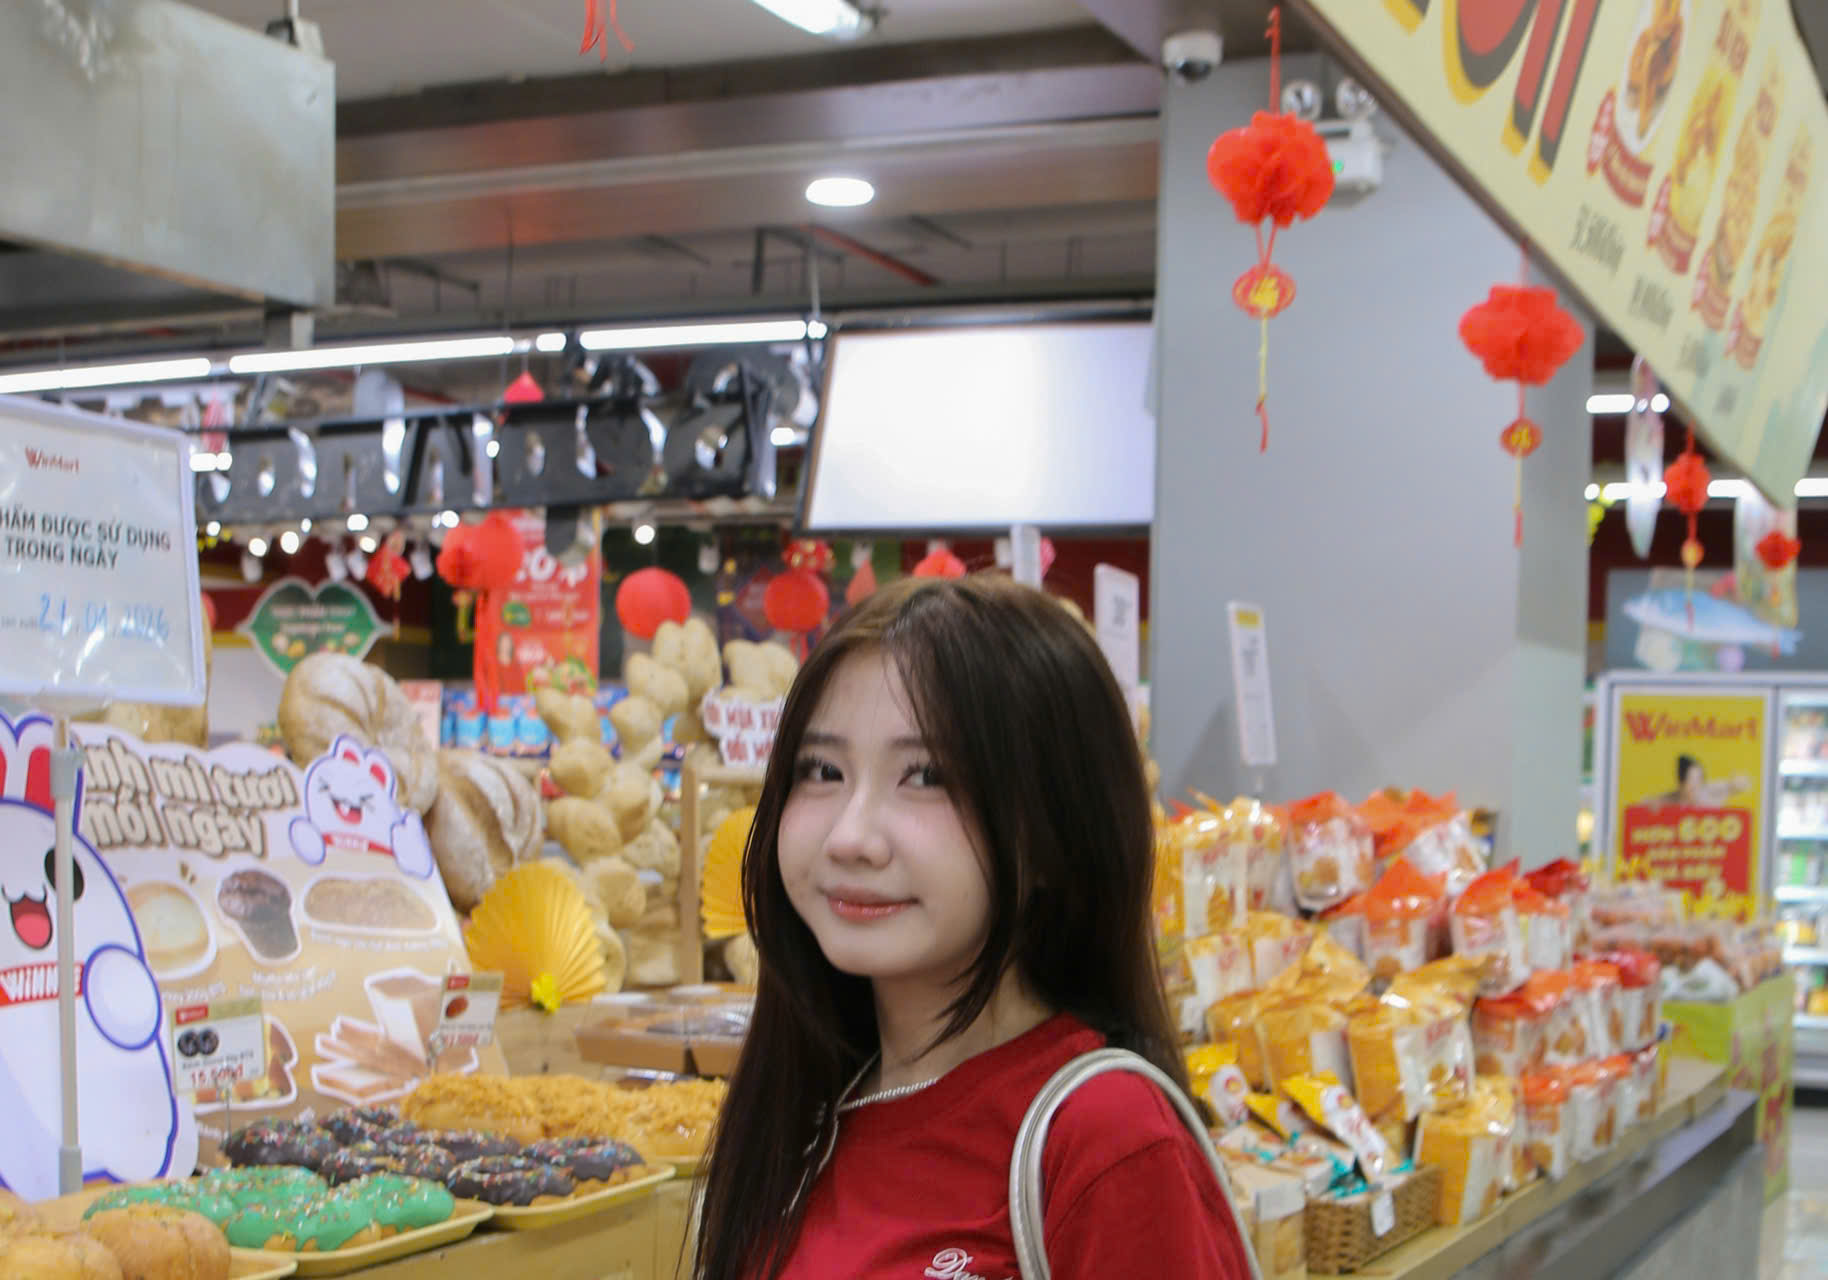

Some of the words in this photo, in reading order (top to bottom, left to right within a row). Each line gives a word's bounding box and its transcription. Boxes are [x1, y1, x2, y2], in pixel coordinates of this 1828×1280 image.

[6, 536, 64, 564] TRONG
[71, 540, 118, 571] NGÀY
[127, 525, 170, 553] DỤNG
